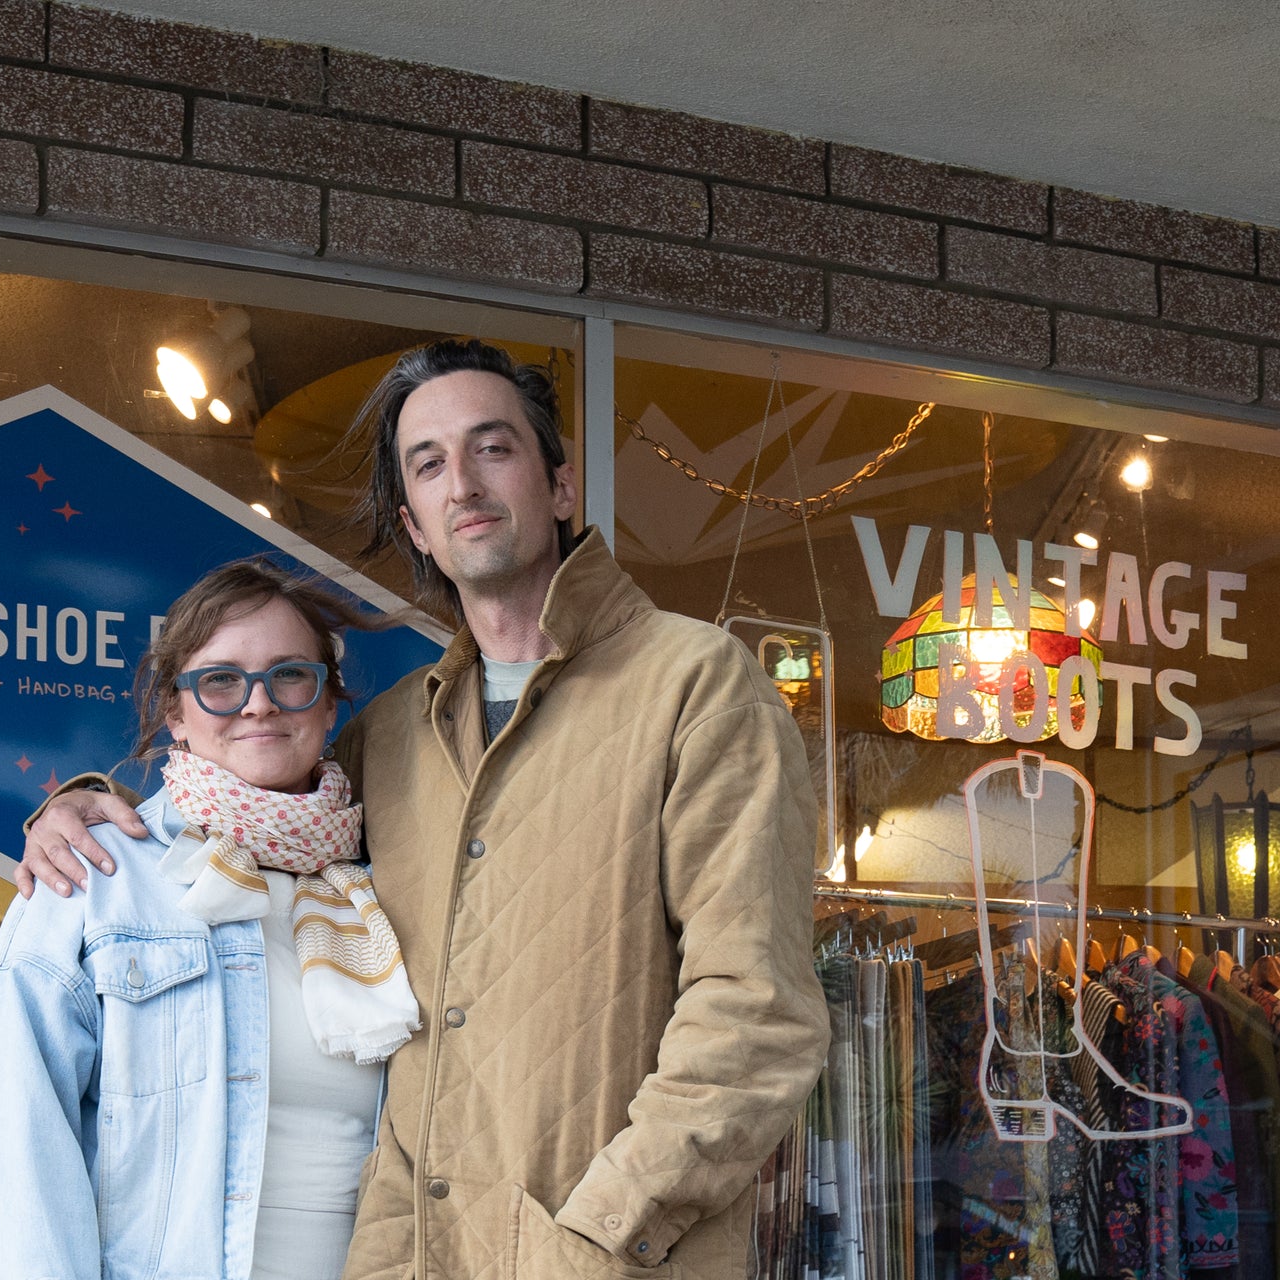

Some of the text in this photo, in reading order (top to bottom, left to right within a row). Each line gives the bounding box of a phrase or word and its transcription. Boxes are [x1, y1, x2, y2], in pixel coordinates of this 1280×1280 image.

[851, 515, 1249, 660] VINTAGE
[18, 676, 115, 703] HANDBAG
[935, 642, 1202, 757] BOOTS
